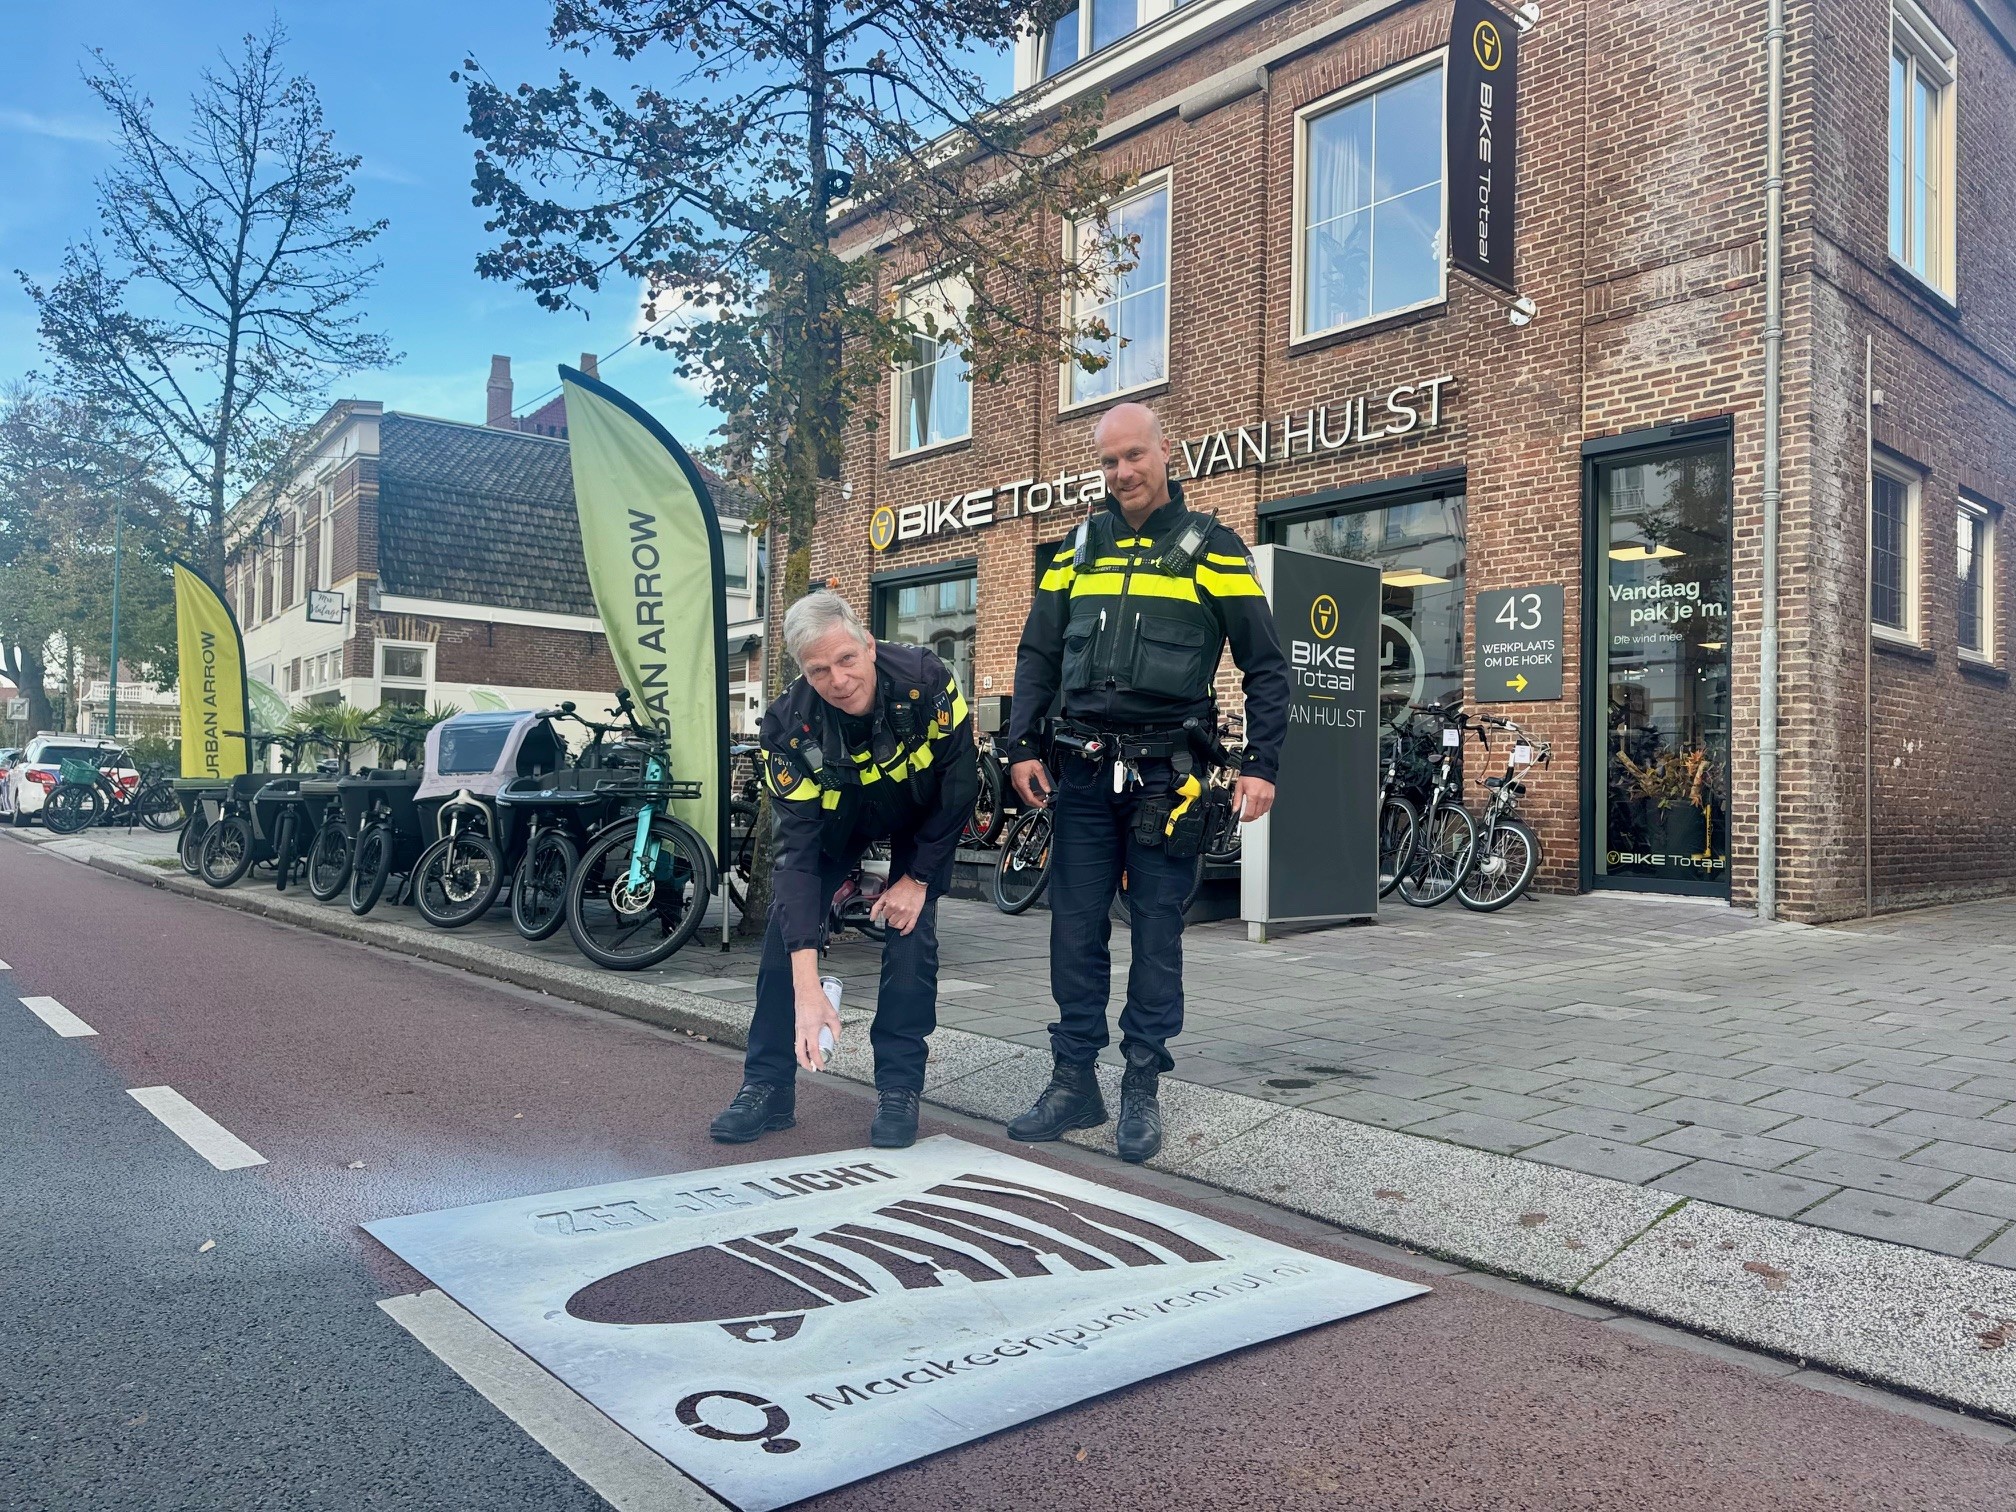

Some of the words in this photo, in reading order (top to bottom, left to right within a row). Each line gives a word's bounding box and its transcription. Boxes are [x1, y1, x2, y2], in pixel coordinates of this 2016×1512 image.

[1479, 81, 1493, 164] BIKE
[1478, 168, 1491, 264] Totaal
[1181, 420, 1268, 478] VAN
[1283, 374, 1455, 459] HULST
[897, 487, 994, 541] BIKE
[999, 467, 1110, 518] Tota
[627, 508, 667, 655] ARROW
[1608, 580, 1701, 602] Vandaag
[1494, 593, 1542, 631] 43
[1630, 602, 1669, 628] pak
[1670, 600, 1694, 624] je
[1697, 599, 1728, 618] 'm.
[1481, 639, 1556, 655] WERKPLAATS
[1632, 633, 1657, 644] wind
[1659, 633, 1685, 642] mee.
[200, 630, 218, 708] ARROW
[1291, 639, 1356, 671] BIKE
[1484, 656, 1503, 668] OM
[1504, 655, 1520, 667] DE
[1521, 653, 1553, 666] HOEK
[1291, 665, 1355, 692] Totaal
[1287, 703, 1311, 724] AN
[1314, 705, 1367, 729] HULST
[1620, 852, 1666, 866] BIKE
[1668, 854, 1726, 869] Totaa
[535, 1200, 660, 1236] ZET
[740, 1162, 900, 1201] LICHT
